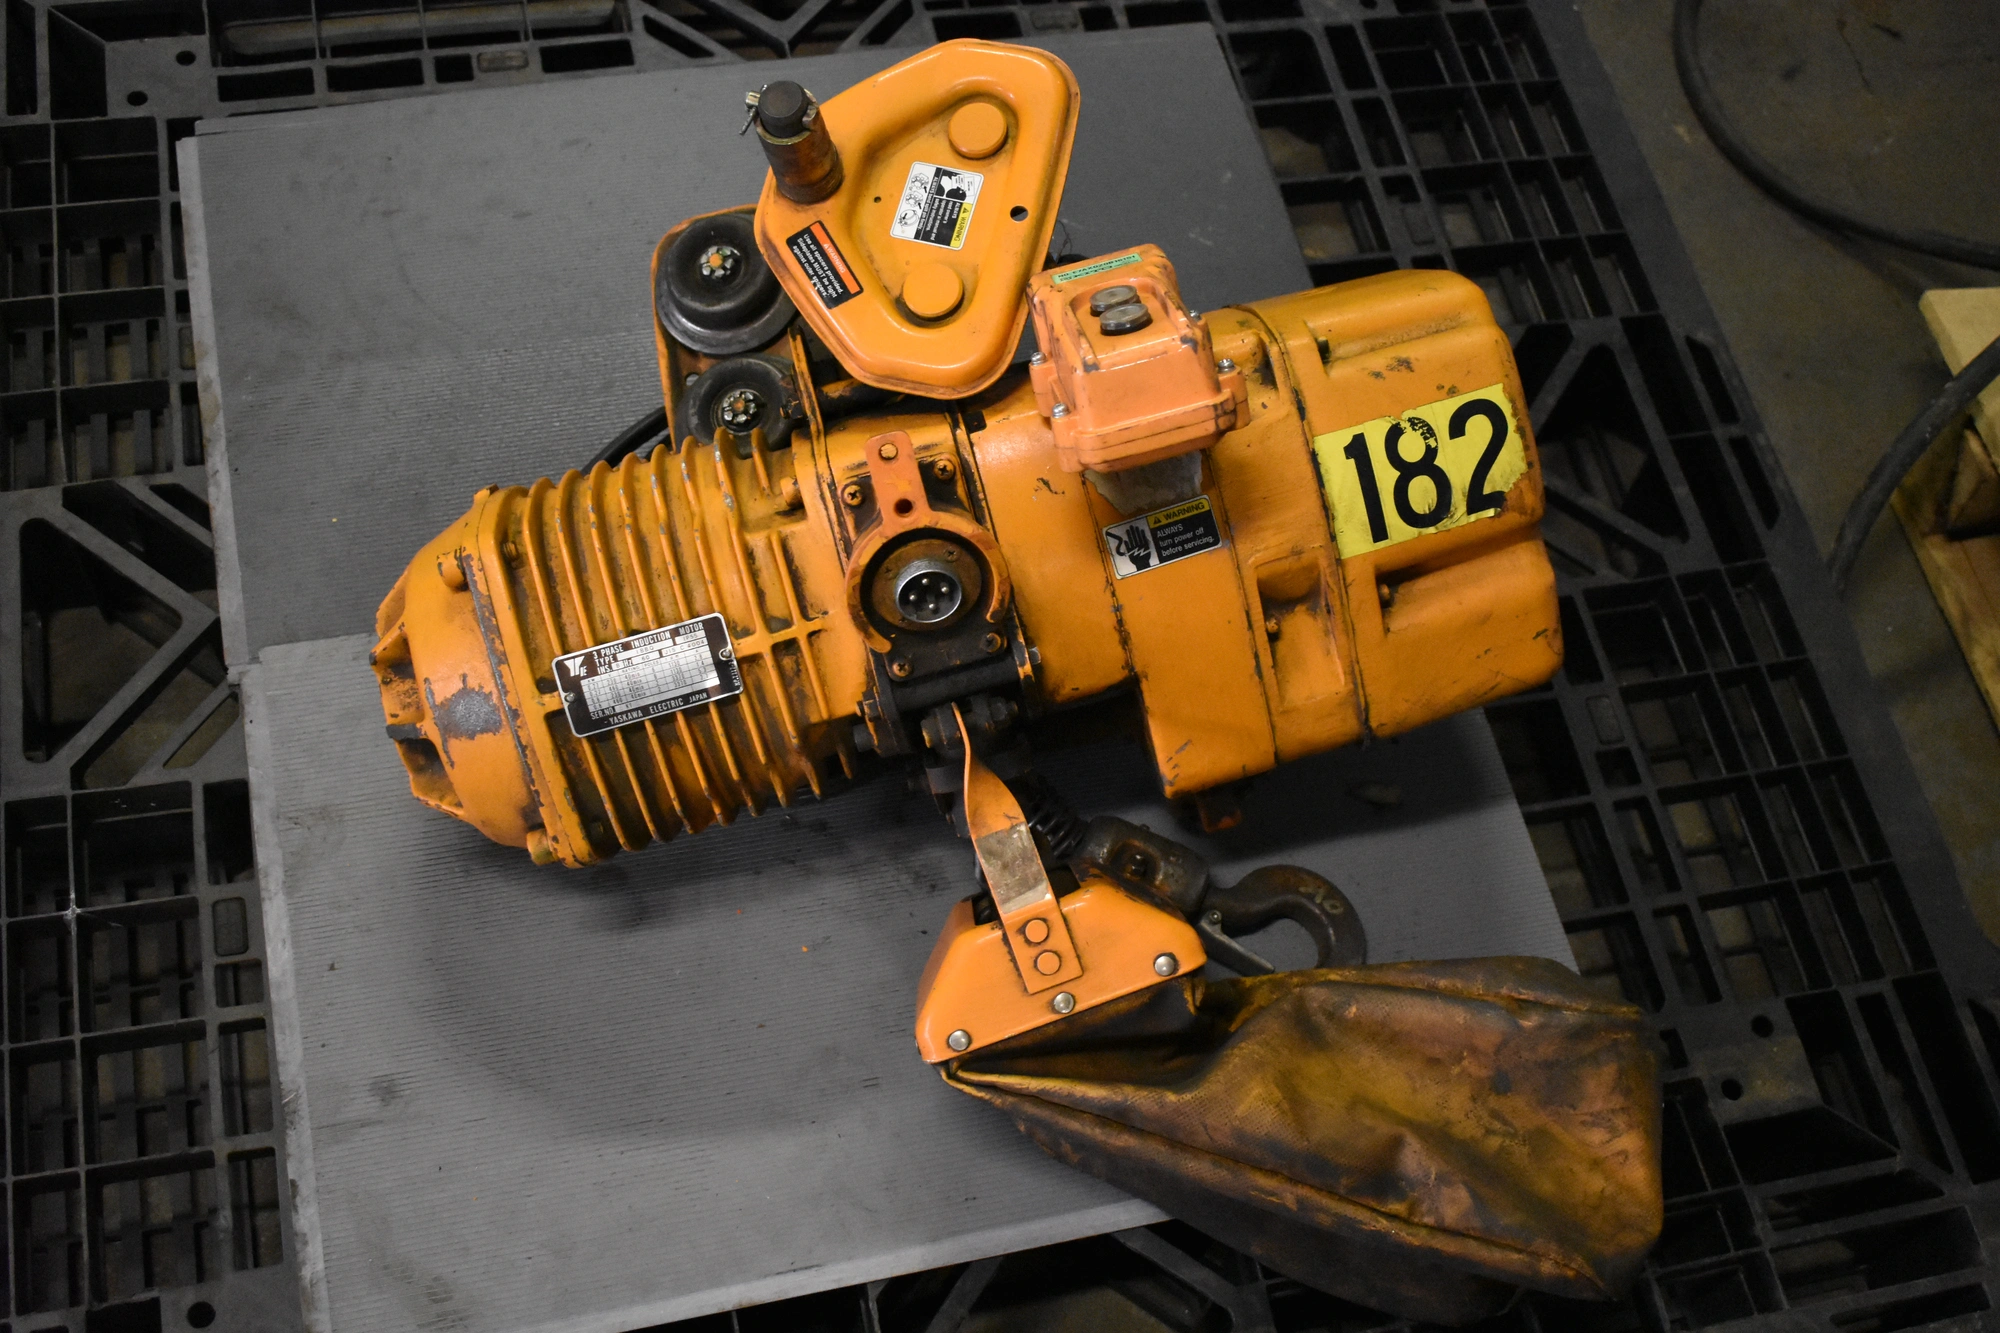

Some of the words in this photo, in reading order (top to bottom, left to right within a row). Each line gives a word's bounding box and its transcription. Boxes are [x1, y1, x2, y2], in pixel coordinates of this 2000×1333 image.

[953, 216, 966, 241] WARNING
[803, 233, 812, 244] Use
[813, 251, 828, 270] spacers
[825, 269, 844, 294] provided.
[827, 247, 845, 273] WARNING
[813, 262, 825, 277] MUST
[822, 277, 829, 285] be
[1343, 399, 1508, 543] 182
[1163, 502, 1205, 521] WARNING
[1157, 524, 1183, 537] ALWAYS
[1159, 539, 1172, 547] turn
[1174, 532, 1193, 543] power
[1196, 527, 1204, 536] off
[1161, 543, 1183, 557] before
[1184, 535, 1214, 550] servicing.
[592, 651, 598, 659] 3
[600, 643, 623, 656] PHASE
[630, 630, 671, 648] INDUCTION
[678, 621, 703, 635] MOTOR
[595, 655, 614, 666] TYPE
[596, 664, 612, 674] INS.
[621, 658, 633, 667] Hz
[686, 638, 704, 647] 4004
[590, 707, 616, 719] SER.NO.
[609, 709, 643, 724] YASKAWA
[649, 698, 683, 713] ELECTRIC
[688, 692, 707, 702] JAPAN
